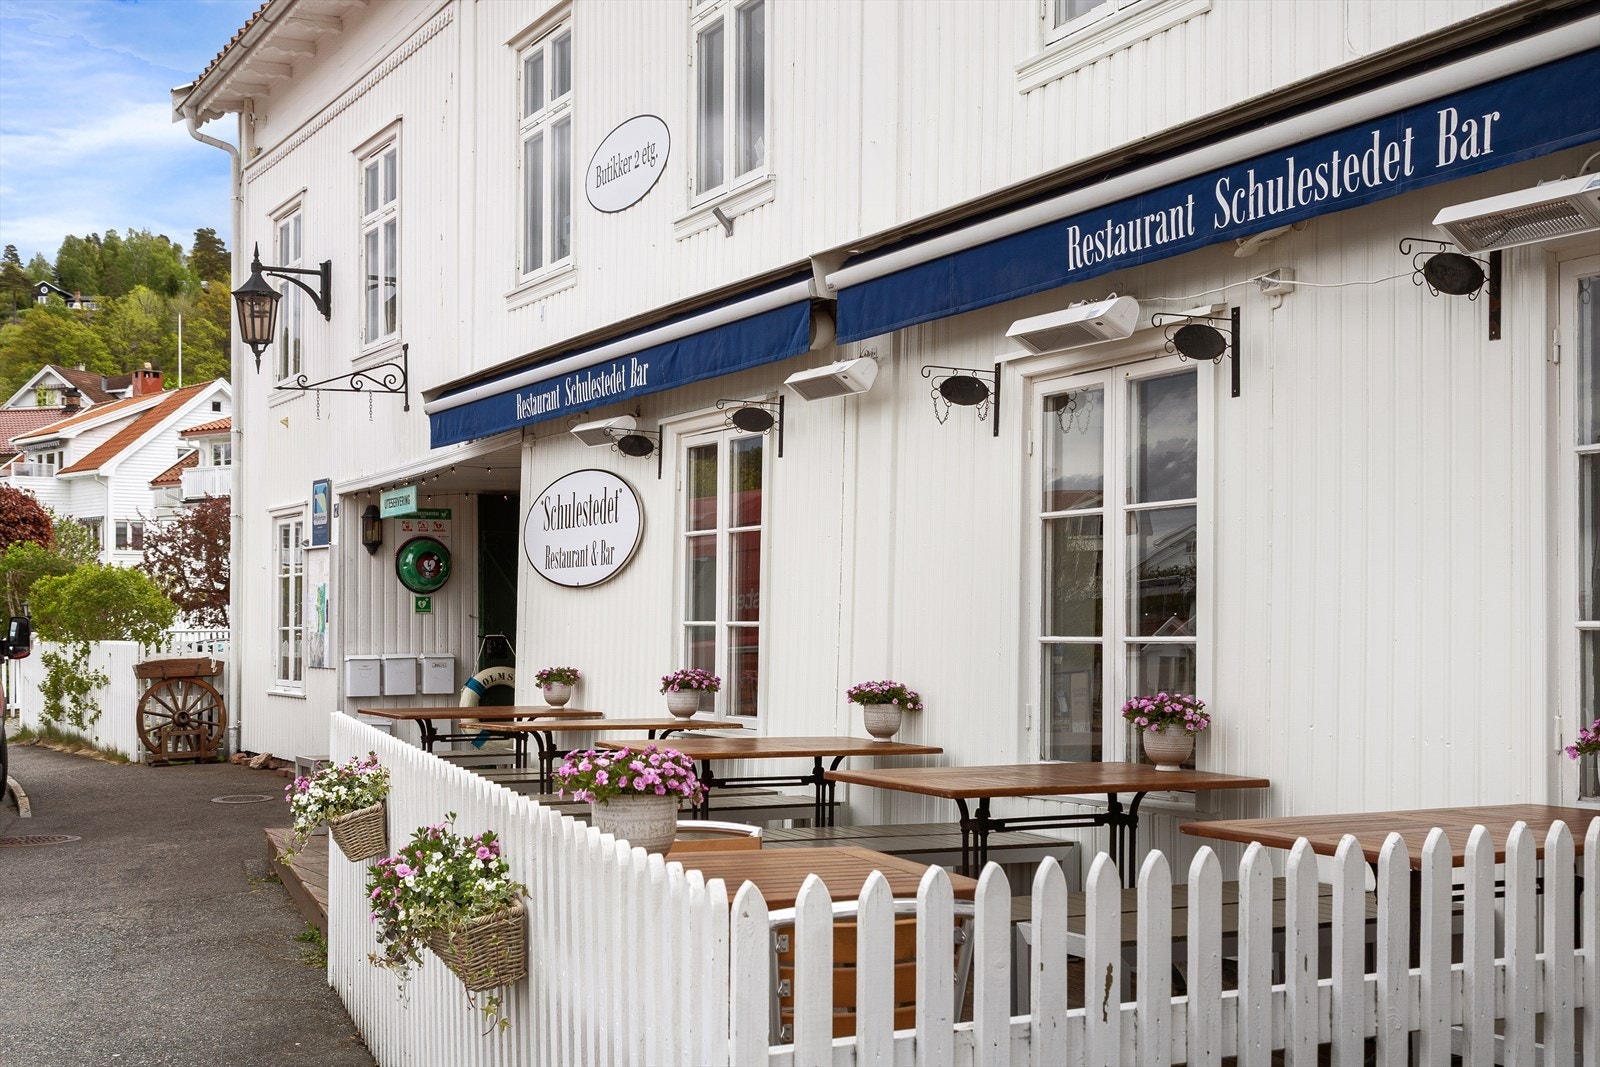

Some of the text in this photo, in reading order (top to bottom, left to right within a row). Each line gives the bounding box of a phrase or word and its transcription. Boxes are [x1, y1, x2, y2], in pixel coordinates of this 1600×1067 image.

[595, 141, 659, 189] Butikker 2 etg.
[1066, 107, 1501, 272] Restaurant Schulestedet Bar
[516, 357, 649, 420] Restaurant Schulestedet Bar
[384, 494, 411, 509] UTESERVERING
[545, 539, 616, 570] Restaurant & Bar
[482, 671, 515, 687] OLMS
